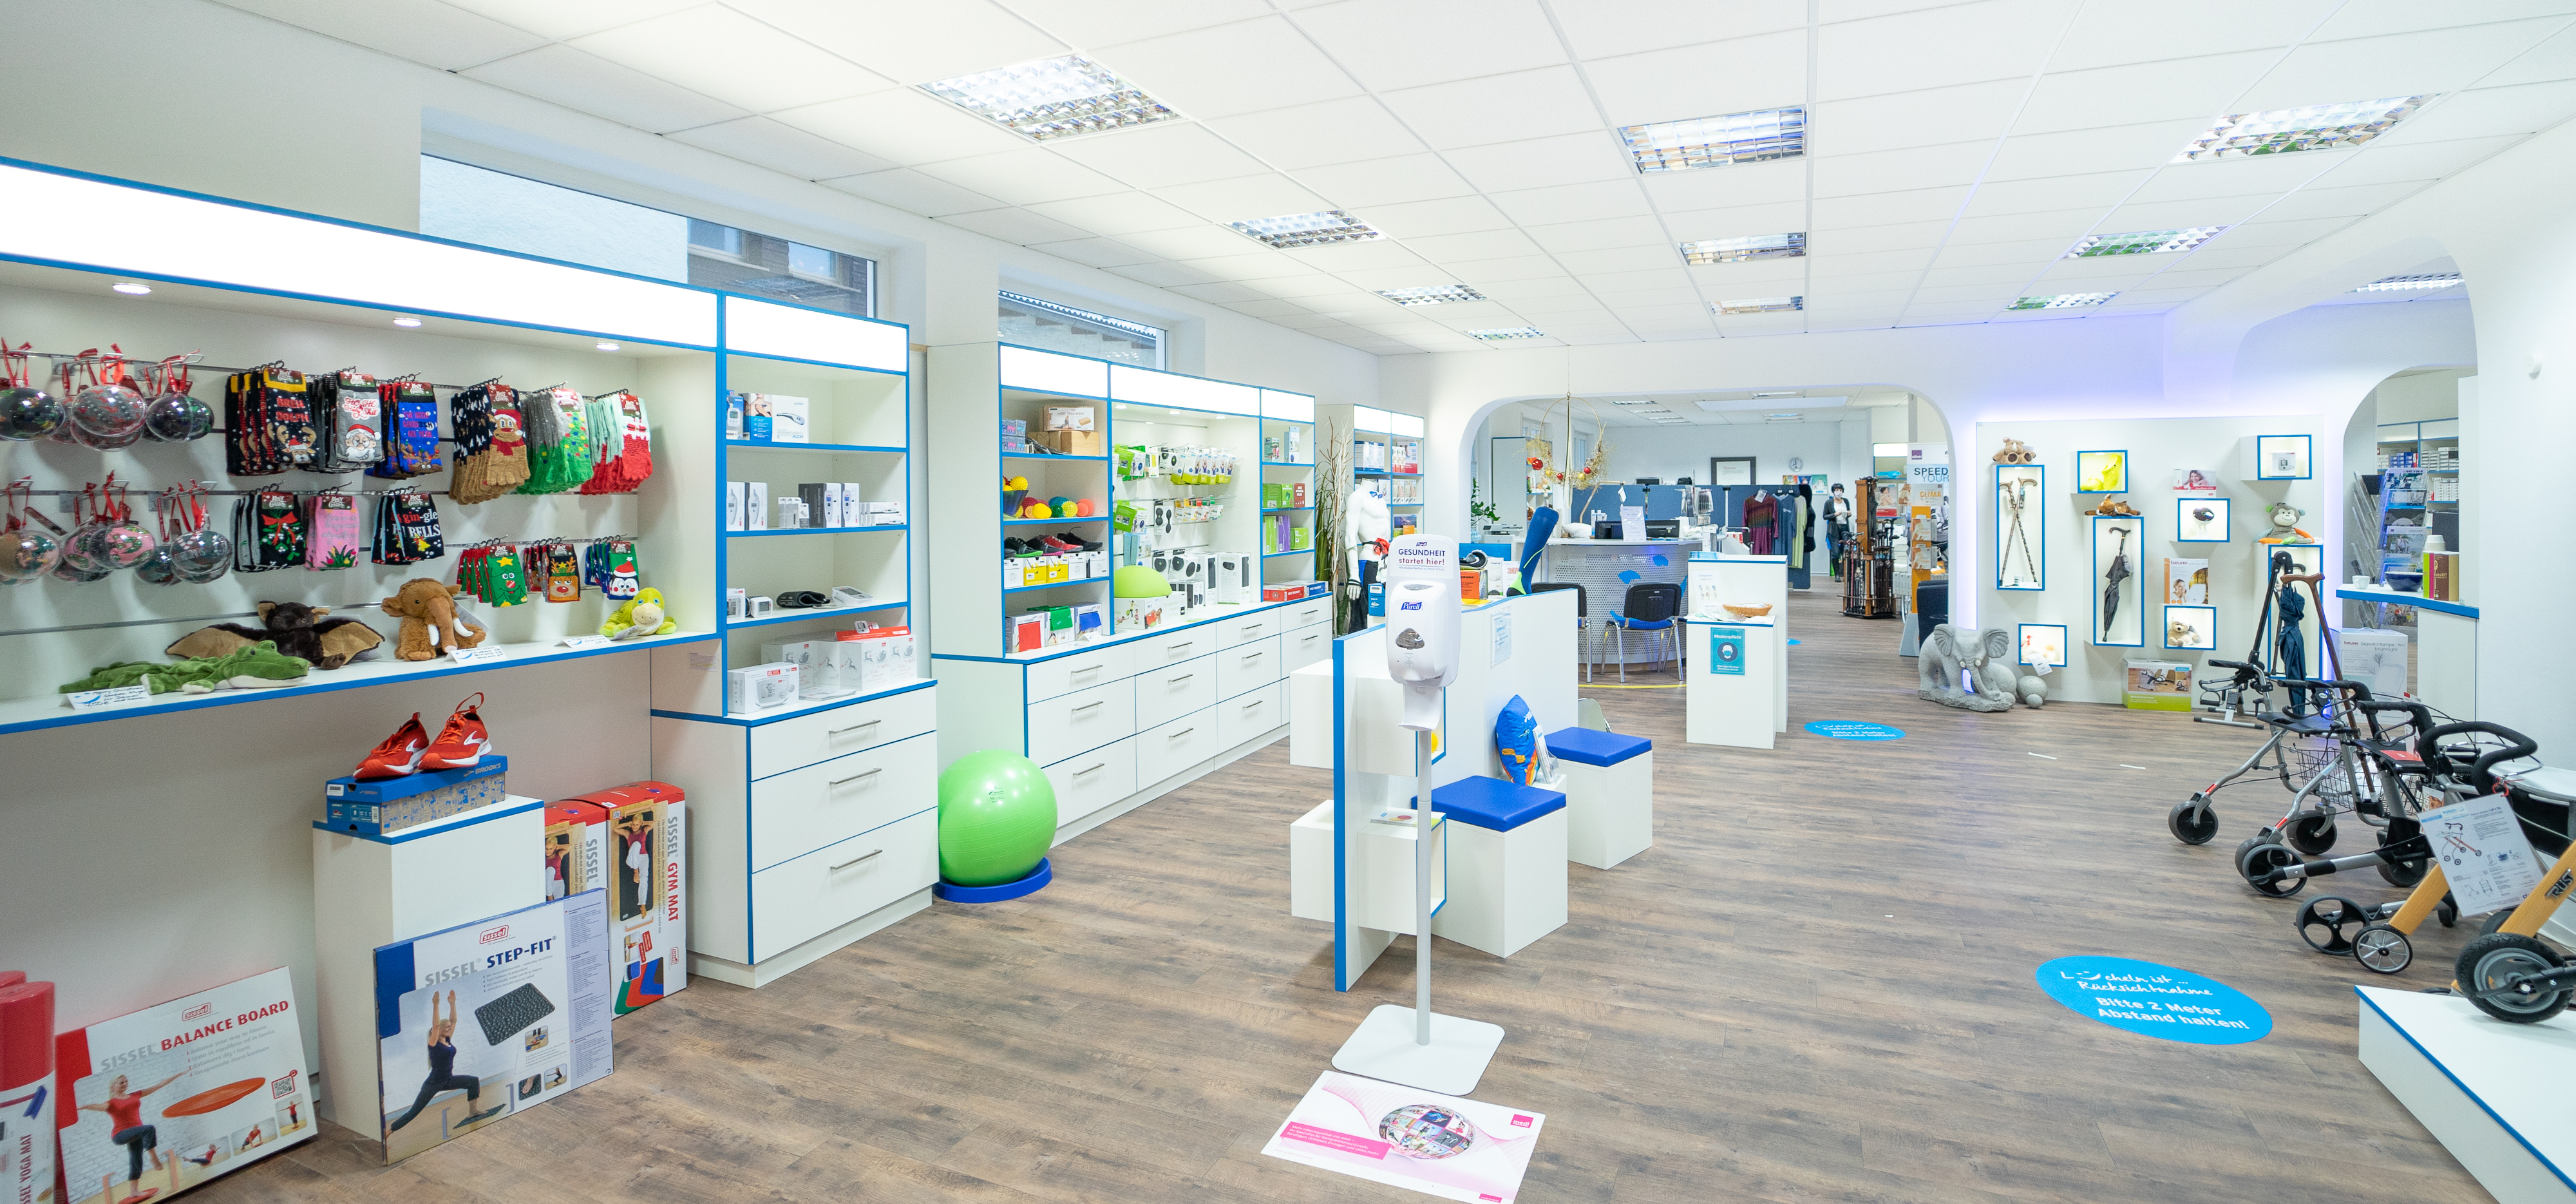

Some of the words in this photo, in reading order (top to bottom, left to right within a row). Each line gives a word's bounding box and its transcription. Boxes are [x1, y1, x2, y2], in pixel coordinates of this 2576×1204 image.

[407, 524, 442, 539] BELLS
[1398, 548, 1446, 557] GESUNDHEIT
[1403, 602, 1421, 610] Purell
[475, 762, 502, 775] BROOKS
[667, 862, 679, 892] GYM
[668, 893, 679, 922] MAT
[483, 927, 506, 942] sissel
[2151, 975, 2172, 985] ist
[2077, 980, 2213, 996] Rücksichtnahme
[185, 1004, 209, 1019] sissel
[2096, 997, 2145, 1009] Bitte
[2147, 1001, 2163, 1011] 2
[2164, 1002, 2222, 1016] Meter
[161, 1018, 232, 1051] BALANCE
[238, 1000, 289, 1026] BOARD
[2098, 1008, 2177, 1023] Abstand
[2181, 1016, 2250, 1029] halten!
[1287, 1132, 1308, 1140] Bandagen,
[1295, 1129, 1316, 1138] Spezialist
[1303, 1127, 1332, 1138] Lebensqualität
[19, 1134, 32, 1155] MAT
[19, 1155, 32, 1183] YOGA
